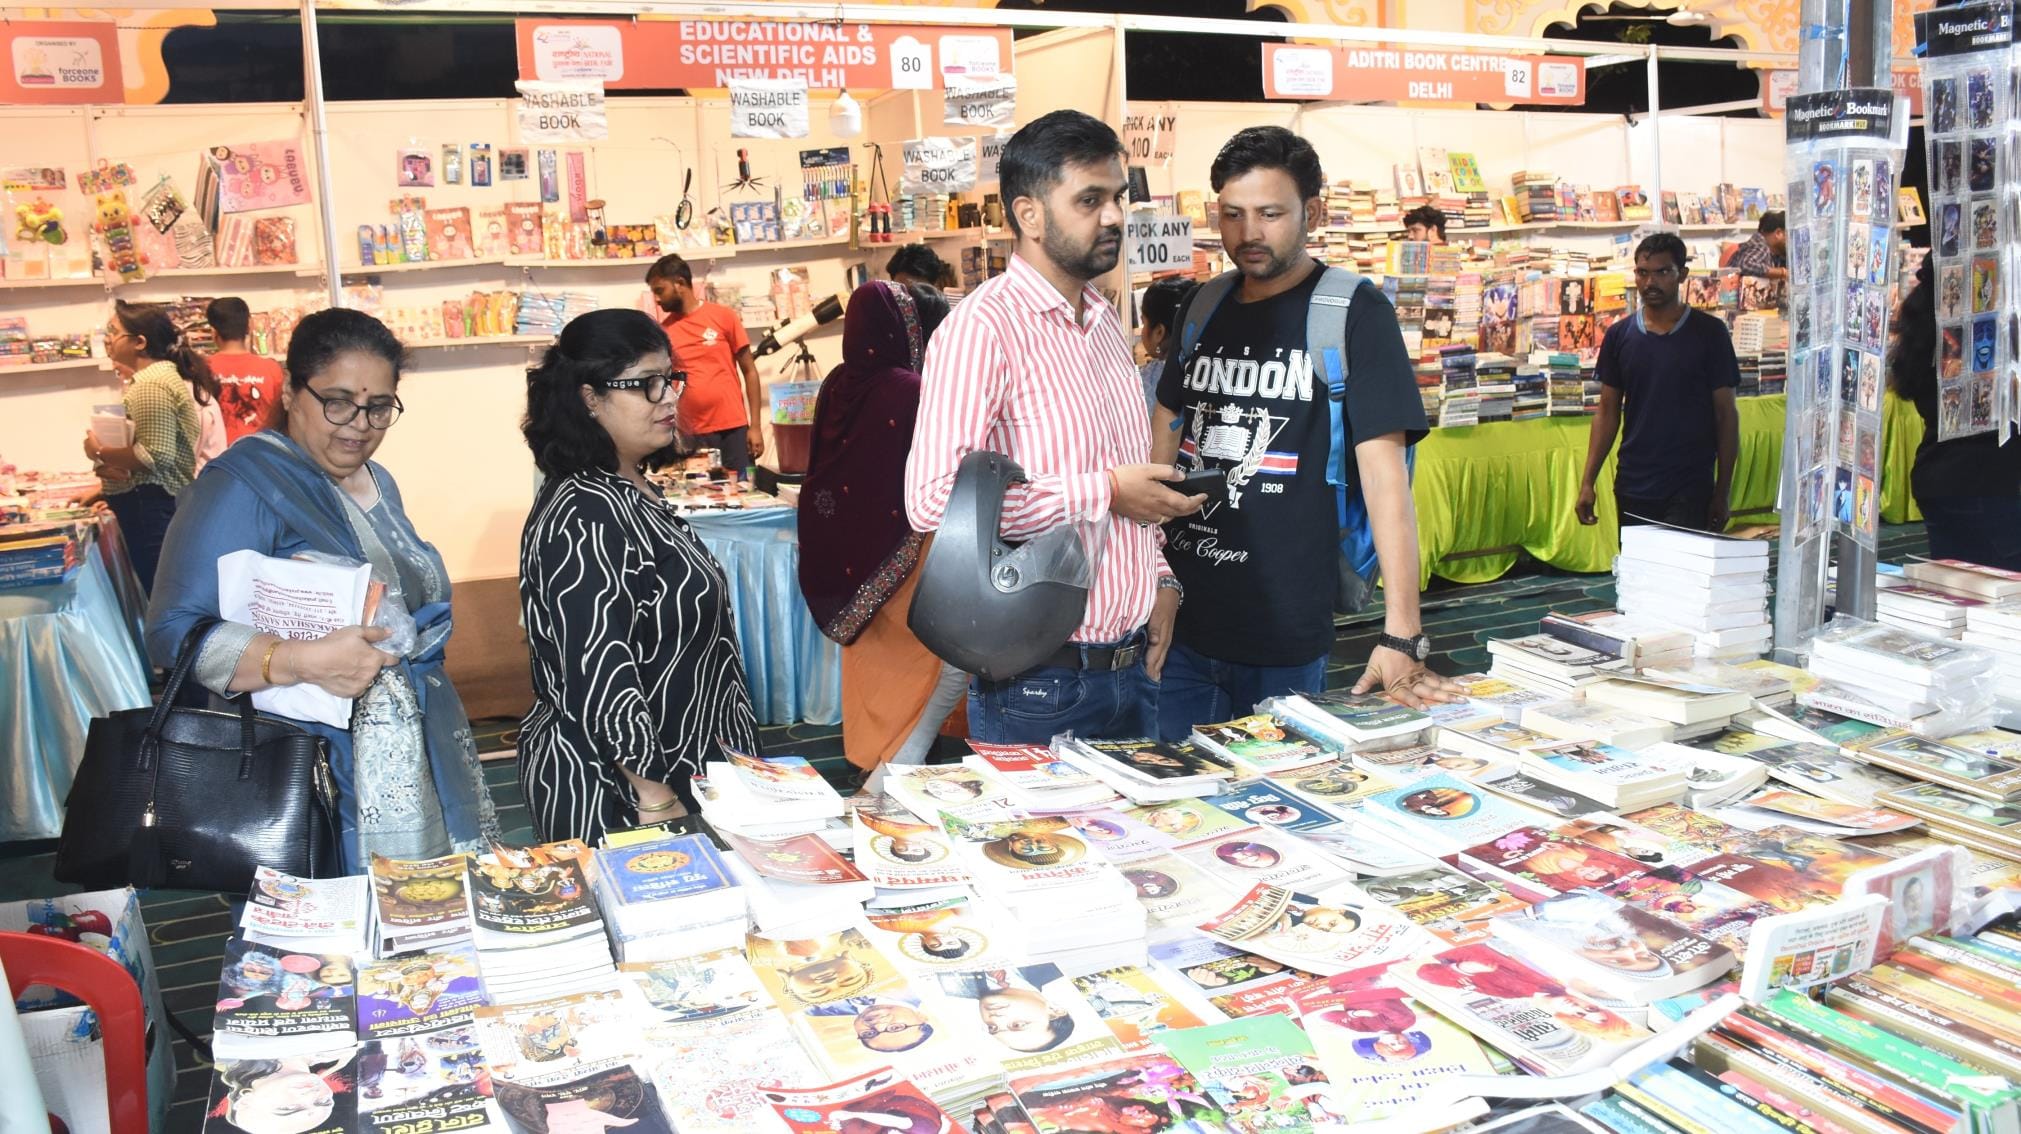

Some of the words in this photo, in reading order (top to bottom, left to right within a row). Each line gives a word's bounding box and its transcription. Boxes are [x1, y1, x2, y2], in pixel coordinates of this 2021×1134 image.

[680, 22, 851, 43] EDUCATIONAL
[857, 23, 873, 43] &
[1938, 19, 1989, 36] Magnetic
[680, 44, 817, 65] SCIENTIFIC
[822, 45, 877, 66] AIDS
[1348, 50, 1401, 69] ADITRI
[1404, 52, 1447, 70] BOOK
[1450, 53, 1508, 72] CENTRE
[59, 67, 99, 76] forceone
[900, 55, 921, 73] 80
[63, 75, 97, 83] BOOKS
[716, 68, 768, 86] NEW
[772, 68, 846, 88] DELHI
[1511, 69, 1526, 84] 82
[945, 86, 1009, 100] WASHABLE
[1408, 81, 1452, 99] DELHI
[731, 92, 800, 107] WASHABLE
[961, 104, 994, 119] BOOK
[1794, 105, 1833, 122] Magnetic
[1846, 101, 1887, 116] Bookmark
[540, 114, 581, 130] BOOK
[748, 112, 785, 128] BOOK
[1126, 116, 1144, 132] PICK
[1147, 116, 1176, 132] ANY
[1131, 136, 1150, 158] 100
[903, 149, 970, 166] WASHABLE
[1451, 152, 1475, 166] KIDS
[285, 148, 304, 194] LABUBU
[921, 167, 956, 184] BOOK
[1455, 166, 1479, 177] COOK
[1458, 176, 1482, 187] BOOK
[1128, 223, 1158, 238] PICK
[1162, 221, 1190, 237] ANY
[1137, 242, 1168, 264] 100
[1173, 255, 1190, 263] EACH
[1260, 482, 1284, 494] 1908
[1188, 522, 1218, 535] ORIGINALS
[1168, 528, 1192, 551] Lee
[1196, 537, 1249, 566] Cooper
[1812, 699, 1843, 712] भारत
[1845, 708, 1861, 718] का
[1863, 711, 1913, 730] संविधान
[226, 1018, 270, 1028] प्रयोग
[272, 1018, 298, 1027] एवं
[281, 1022, 351, 1035] वशीकरण
[299, 1015, 350, 1026] साधना
[370, 1107, 448, 1125] निवारण
[435, 1113, 485, 1130] दान
